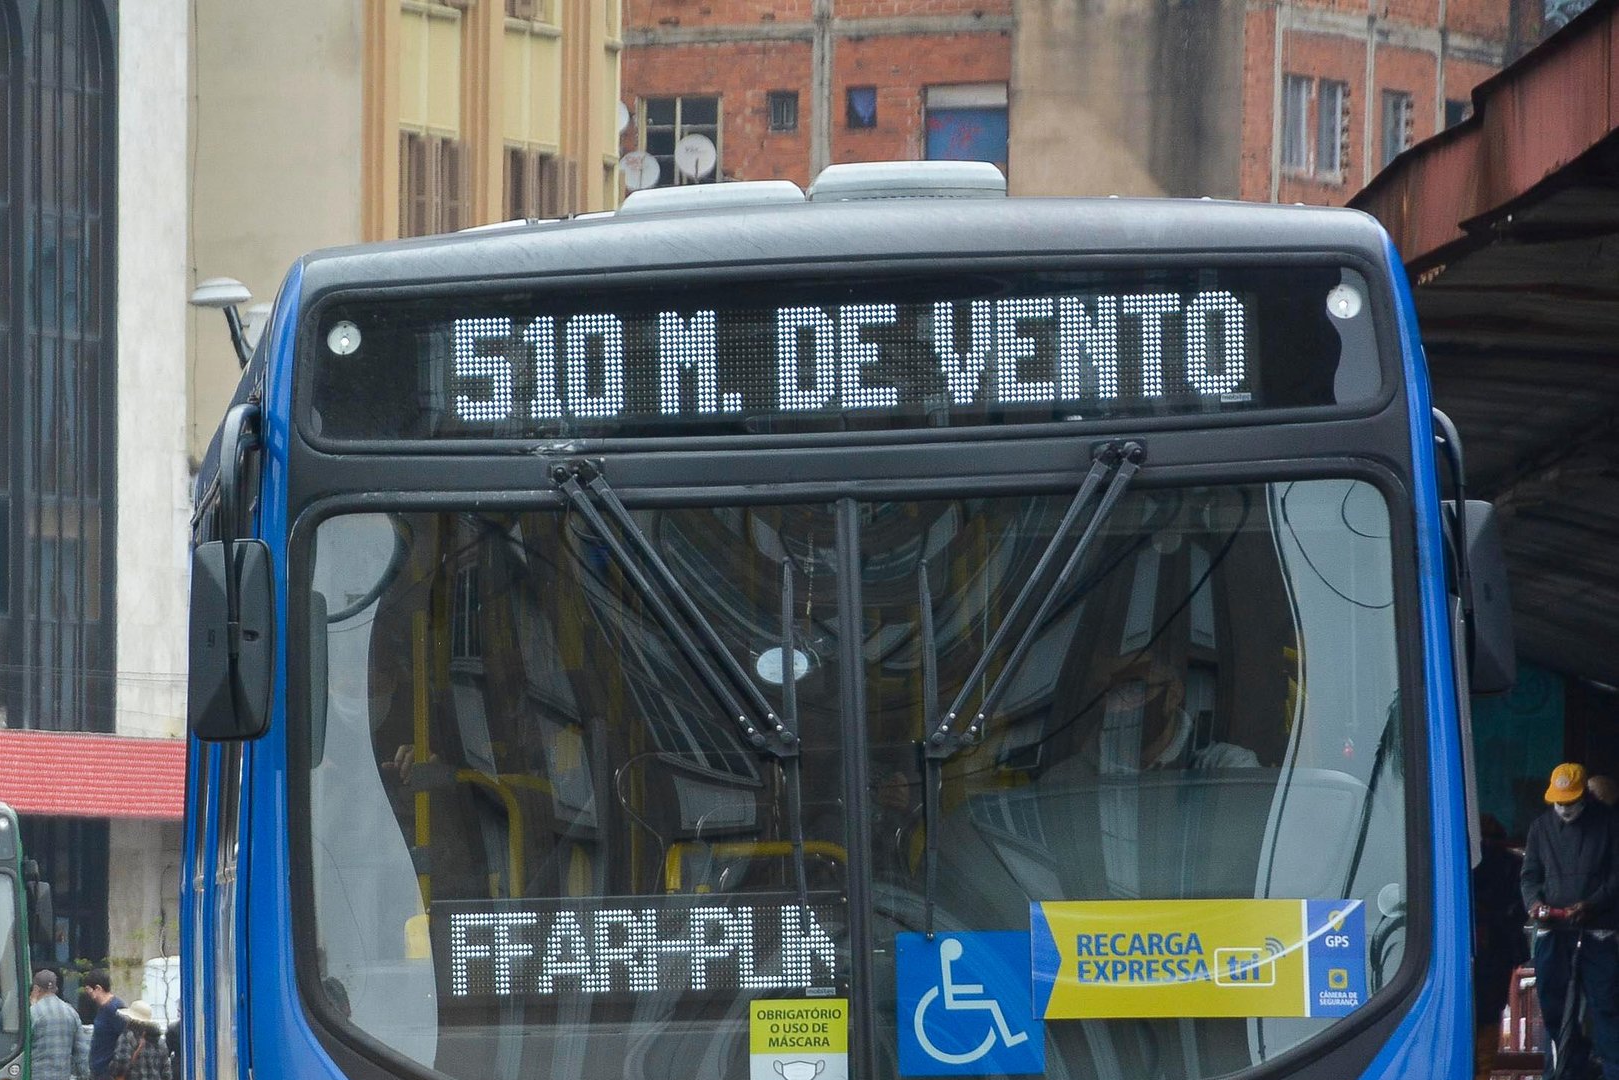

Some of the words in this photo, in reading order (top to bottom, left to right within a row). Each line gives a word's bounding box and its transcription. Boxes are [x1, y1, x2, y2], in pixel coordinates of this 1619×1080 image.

[455, 313, 624, 421] 510
[659, 310, 743, 414] M.
[778, 304, 899, 411] DE
[934, 290, 1246, 404] VENTO
[1076, 932, 1204, 957] RECARGA
[1325, 935, 1350, 948] GPS
[1077, 959, 1212, 984] EXPRESSA
[1227, 953, 1260, 981] tri
[1348, 991, 1358, 999] DE
[1319, 999, 1359, 1007] SEGURANÇA
[757, 1007, 842, 1020] OBRIGATÓRIO
[770, 1023, 780, 1034] O
[783, 1023, 809, 1034] USO
[812, 1022, 829, 1033] DE
[768, 1034, 830, 1047] MÁSCARA
